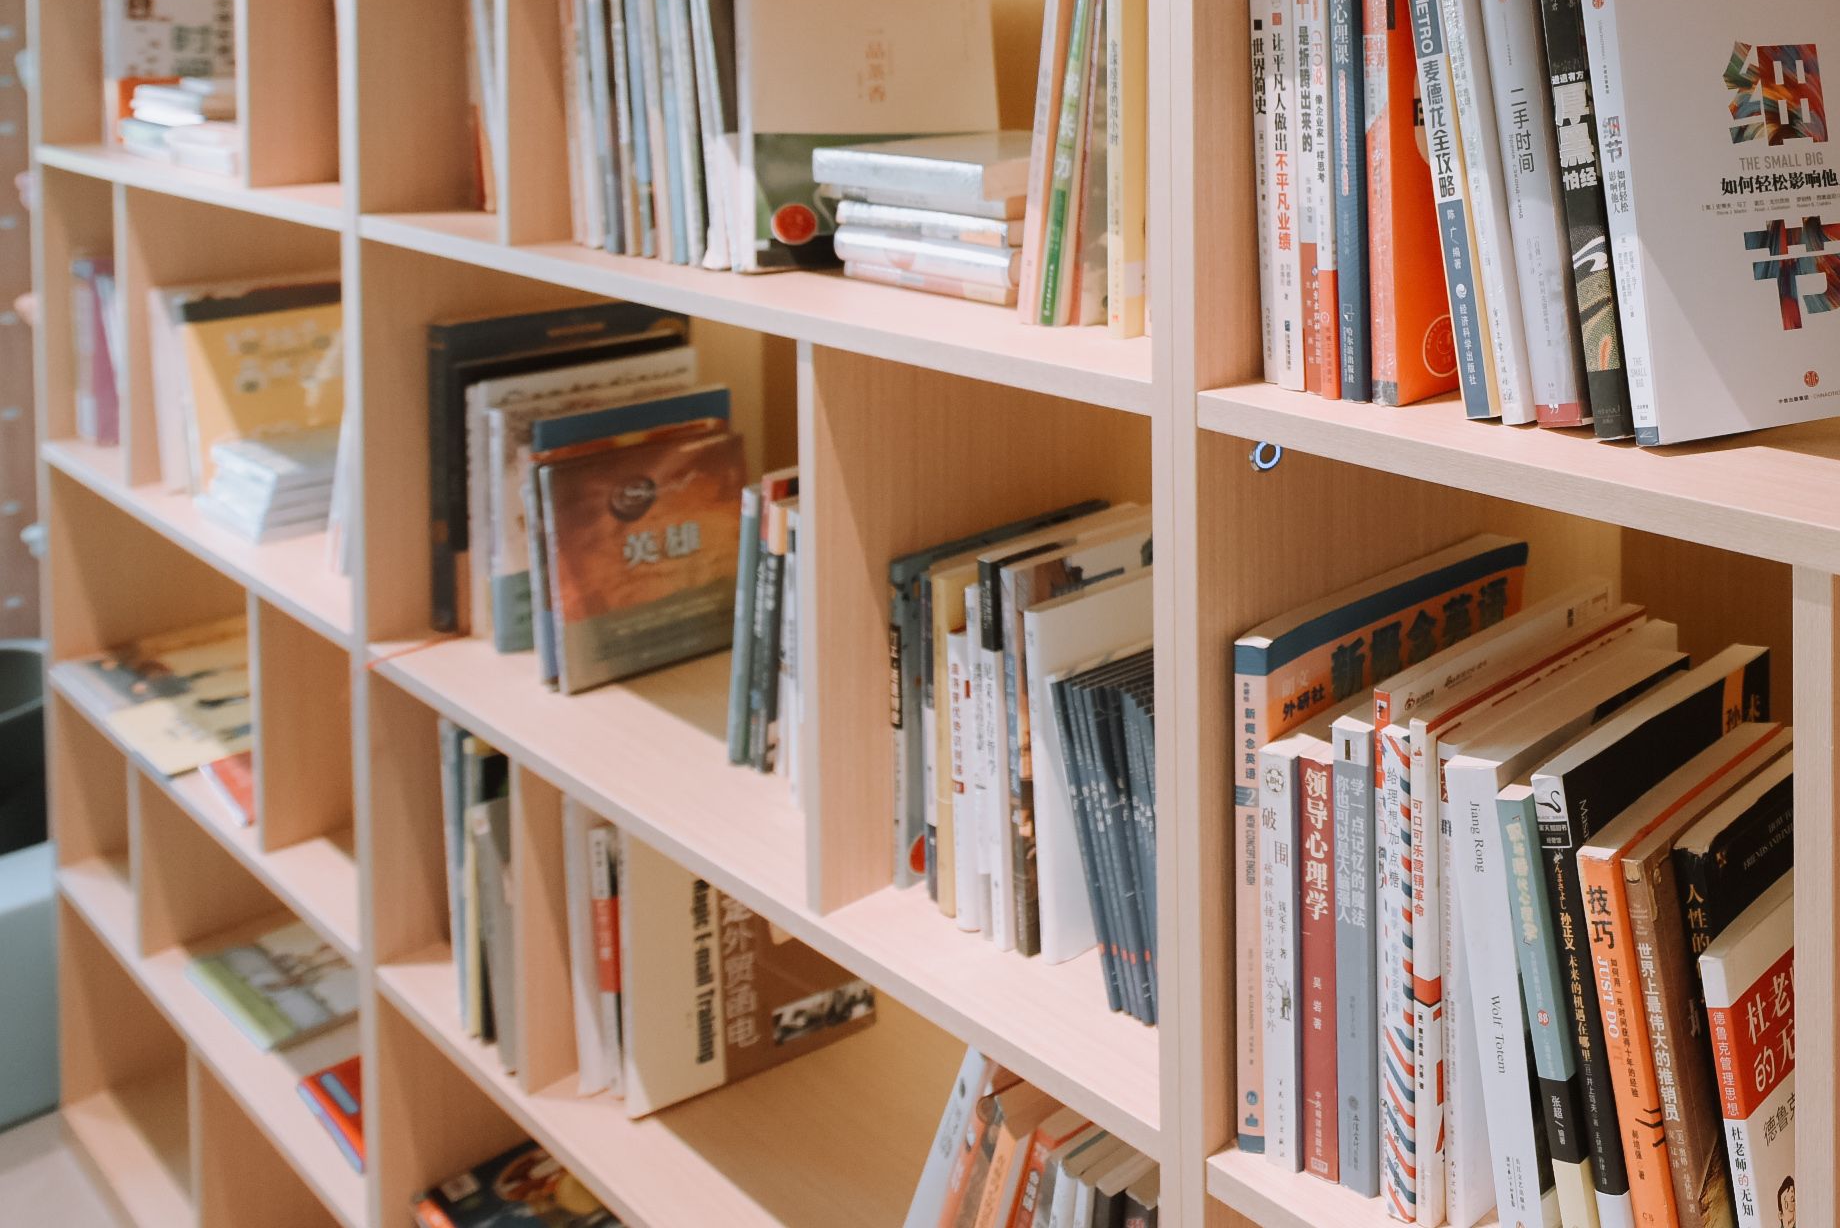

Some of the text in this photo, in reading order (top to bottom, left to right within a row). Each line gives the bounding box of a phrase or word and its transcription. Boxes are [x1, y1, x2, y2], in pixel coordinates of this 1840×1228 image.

[1251, 38, 1267, 115] 世界简史
[1722, 40, 1829, 147] 细
[1271, 33, 1292, 252] 让平凡人做出不平凡业绩
[1422, 59, 1458, 197] 麦德龙全攻略
[1510, 87, 1535, 174] 二手时间
[1602, 115, 1624, 164] 细节
[1739, 151, 1825, 172] THE SMALL BIG
[1459, 303, 1478, 386] 经济科学出版社
[1282, 683, 1327, 721] 外研社
[1244, 707, 1256, 781] 新概念英语
[1261, 807, 1290, 868] 破围
[1303, 767, 1329, 921] 领导心理学
[1348, 776, 1367, 929] 学一点记忆的魔法
[1386, 765, 1400, 890] 给理想加点糖
[1410, 797, 1425, 918] 可口可乐营销革命
[1469, 801, 1487, 874] Jiang Rong
[1559, 911, 1576, 951] 孙正义
[1586, 884, 1615, 950] 技巧
[1489, 994, 1506, 1074] Wolf Totem
[1538, 1011, 1550, 1025] 88
[1567, 956, 1592, 1062] 未来的机遇在哪里
[1596, 956, 1620, 1039] JUST DO
[1637, 942, 1681, 1123] 世界上最伟大的推销员
[1746, 965, 1795, 1045] 杜老
[1712, 1011, 1740, 1117] 德鲁克管理思想
[1730, 1125, 1755, 1218] 杜老师的无知
